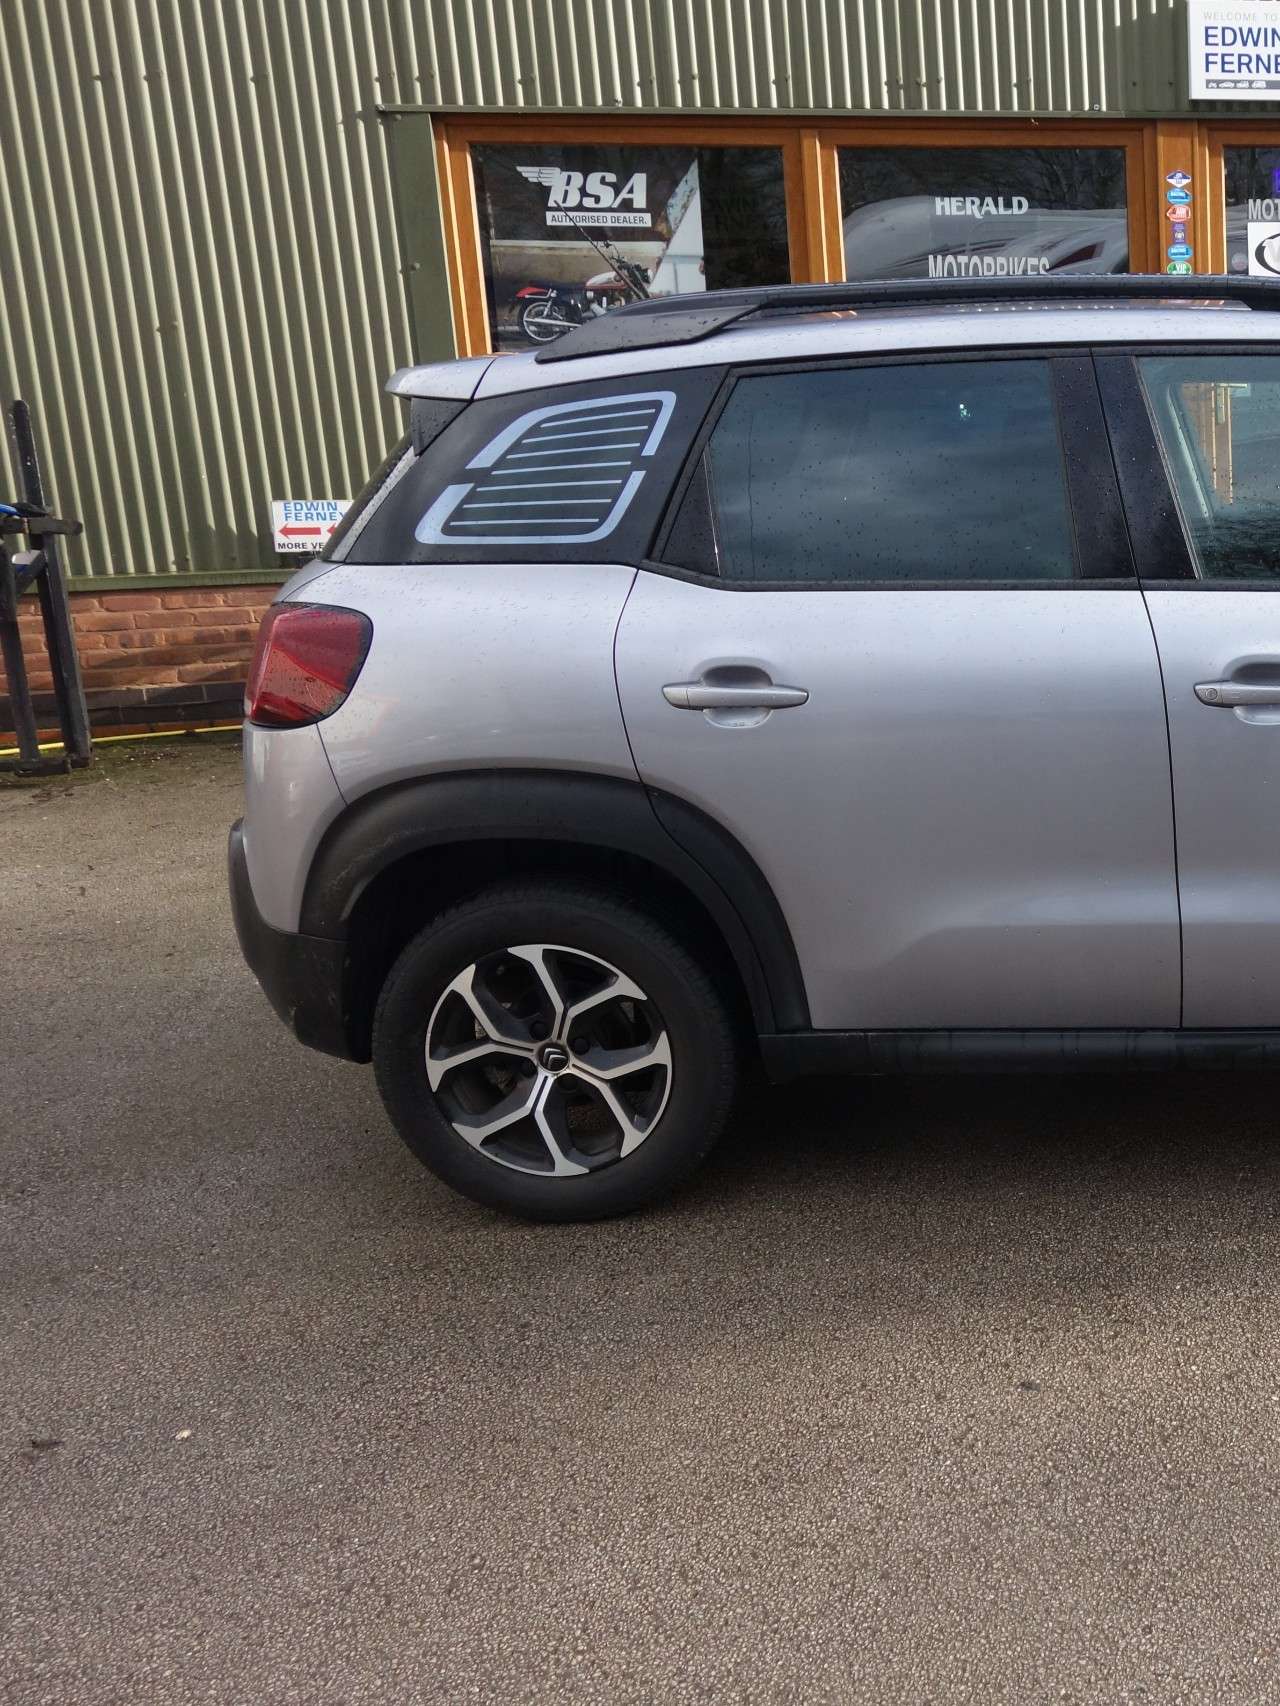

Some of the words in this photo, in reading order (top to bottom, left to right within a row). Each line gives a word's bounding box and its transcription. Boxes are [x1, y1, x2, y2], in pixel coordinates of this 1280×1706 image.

[1203, 11, 1256, 21] WELCOME
[548, 171, 647, 208] BSA
[935, 196, 1029, 219] HERALD
[551, 214, 608, 225] AUTHORISED
[283, 502, 338, 512] EDWIN
[277, 542, 307, 550] MORE
